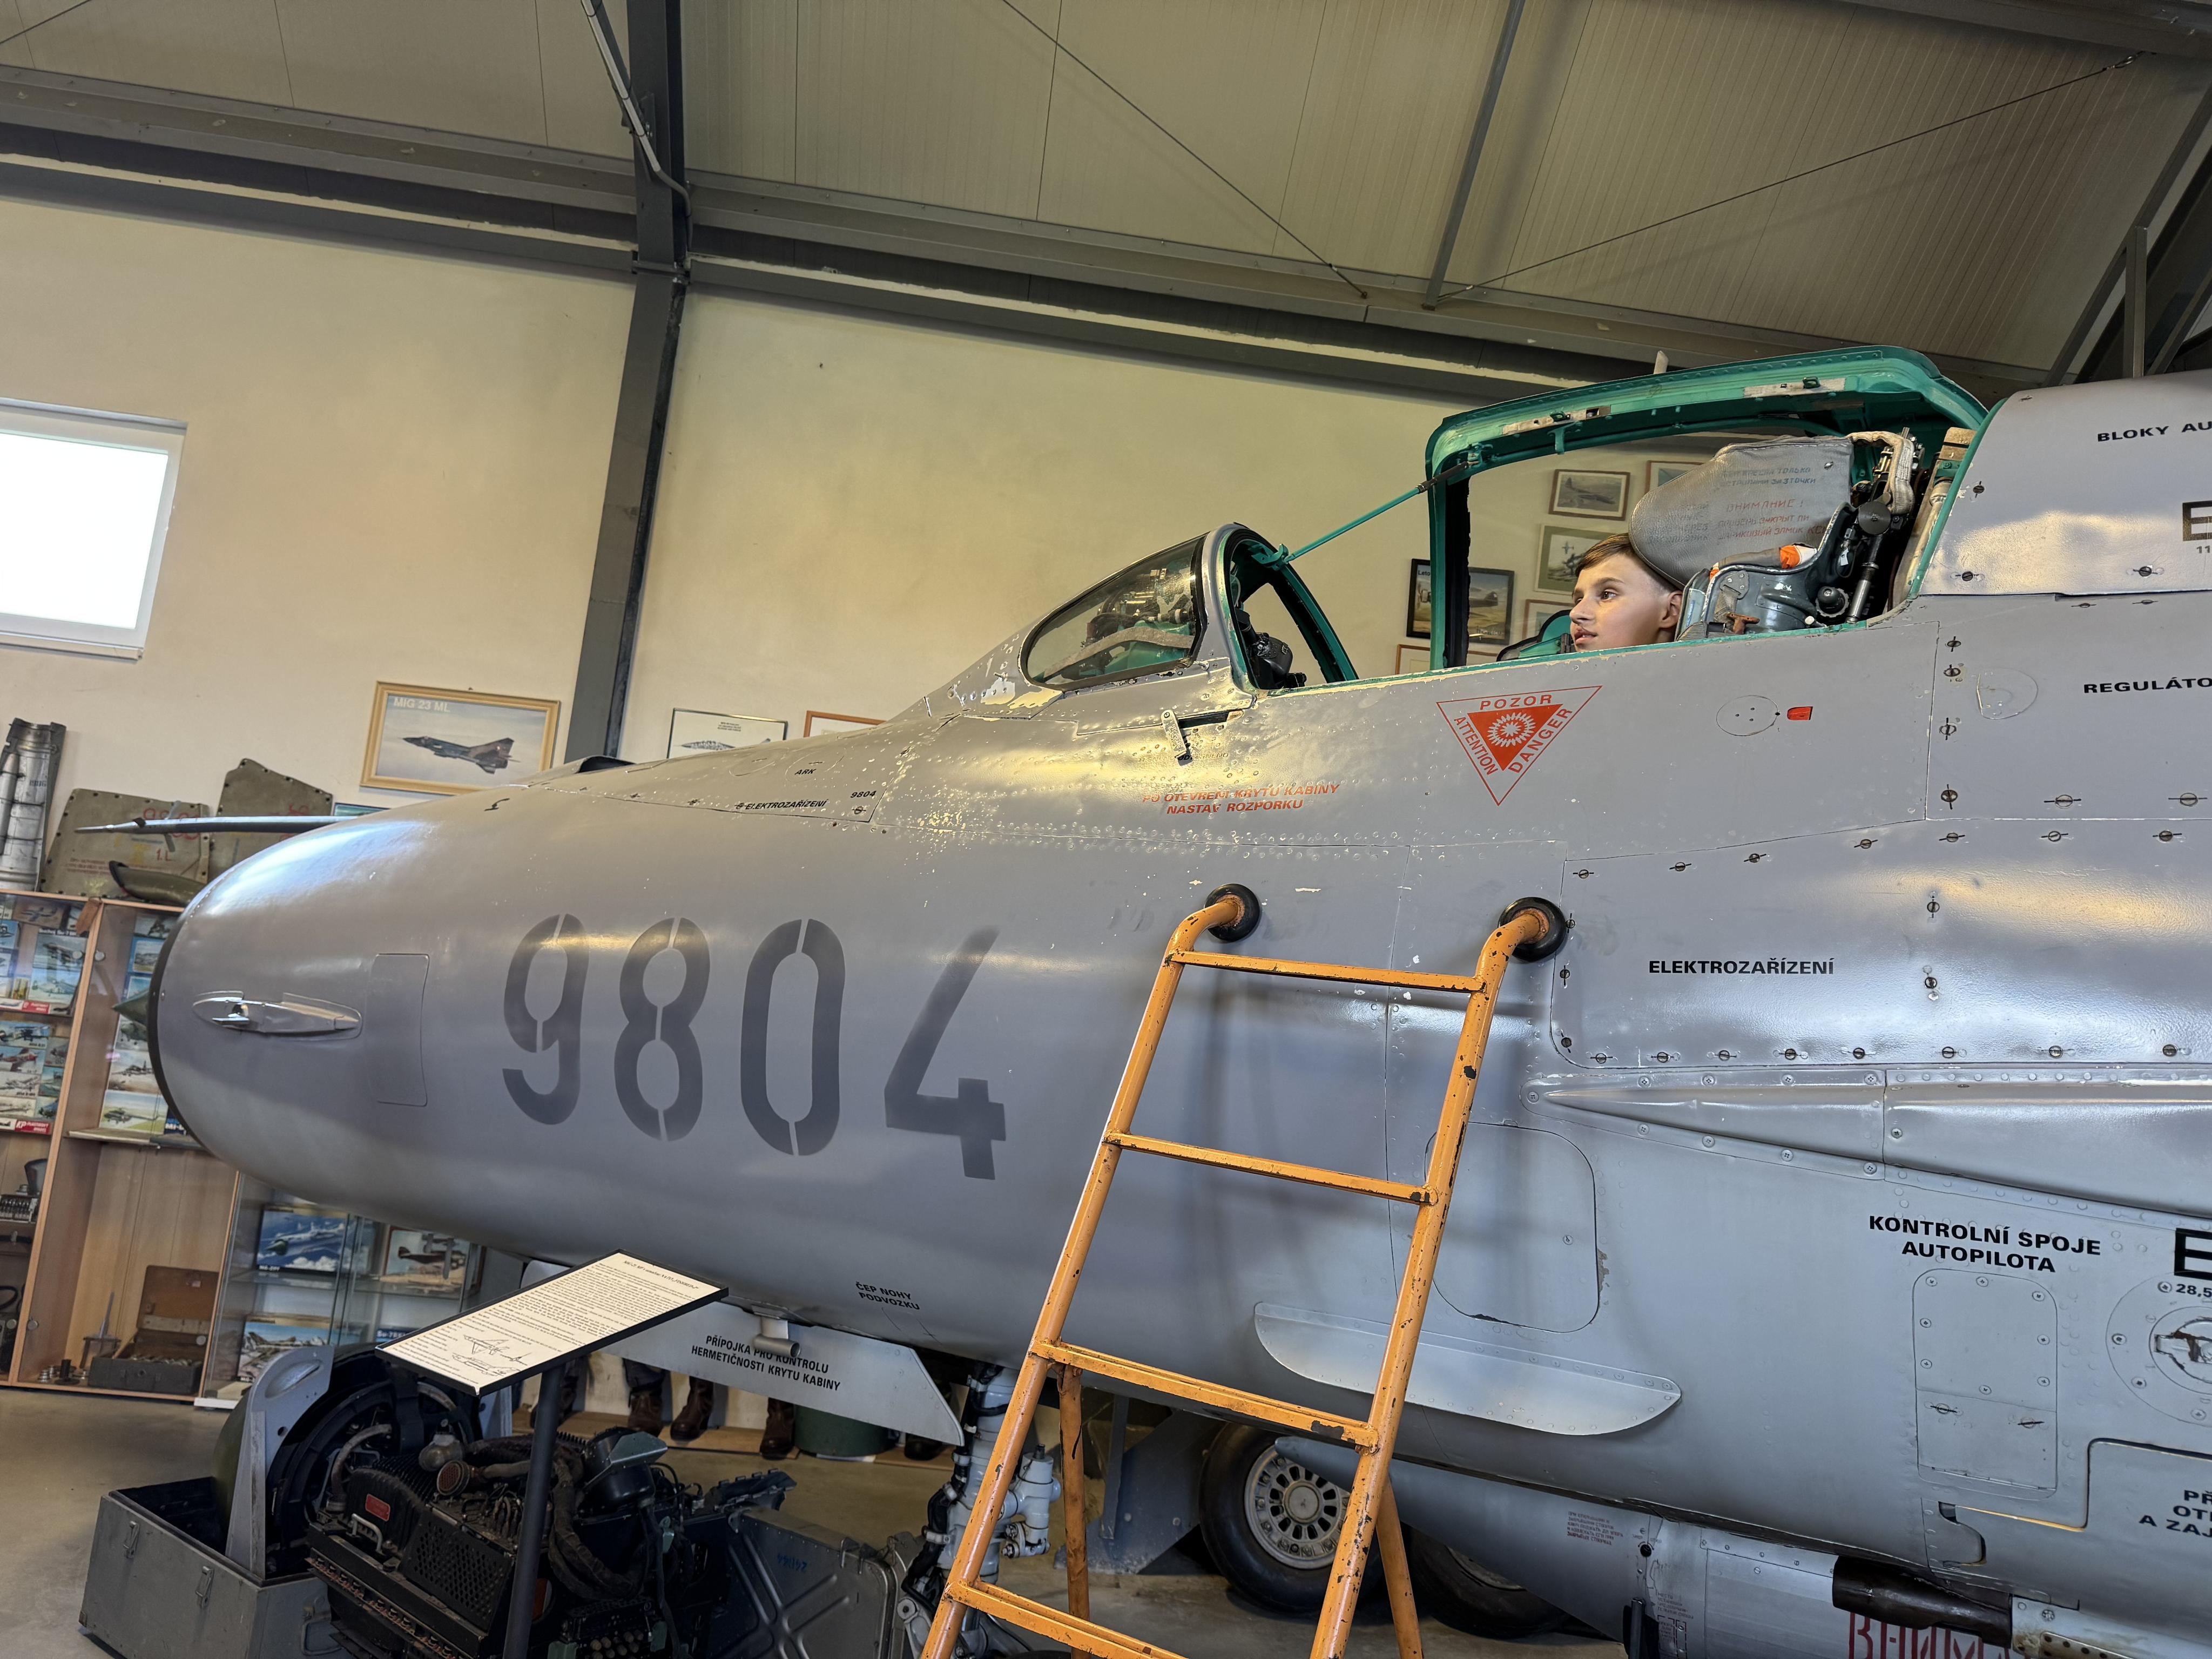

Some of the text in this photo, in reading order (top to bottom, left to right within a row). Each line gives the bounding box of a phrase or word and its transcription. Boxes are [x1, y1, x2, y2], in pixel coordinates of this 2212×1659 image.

[2098, 421, 2212, 442] BLOKY AU
[2084, 677, 2212, 693] REGULÁTO
[417, 700, 431, 710] 23
[434, 702, 450, 712] ML
[1480, 694, 1552, 710] POZOR
[1454, 717, 1498, 775] ATTENTION
[1508, 709, 1573, 773] DANGER
[1142, 794, 1159, 803] PO
[1235, 786, 1280, 799] KRYTU
[1284, 784, 1340, 796] KABINY
[745, 799, 828, 810] ELEKTROZAŘÍZENÍ
[1166, 799, 1304, 814] NASTAV ROZPORKU
[1649, 957, 1835, 974] ELEKTROZAŘÍZENÍ
[502, 913, 1006, 1180] 9804
[1869, 1215, 2101, 1256] KONTROLNÍ SPOJE
[1901, 1242, 2055, 1273] AUTOPILOTA
[856, 1281, 912, 1300] ČEP NOHY
[2176, 1284, 2212, 1298] 28,5
[859, 1292, 920, 1310] PODVOZKU
[706, 1334, 750, 1355] PŘÍPOJKA
[691, 1345, 840, 1391] HERMETIČNOSTI KRYTU KABINY
[2139, 1515, 2157, 1527] A
[2173, 1506, 2212, 1522] OT
